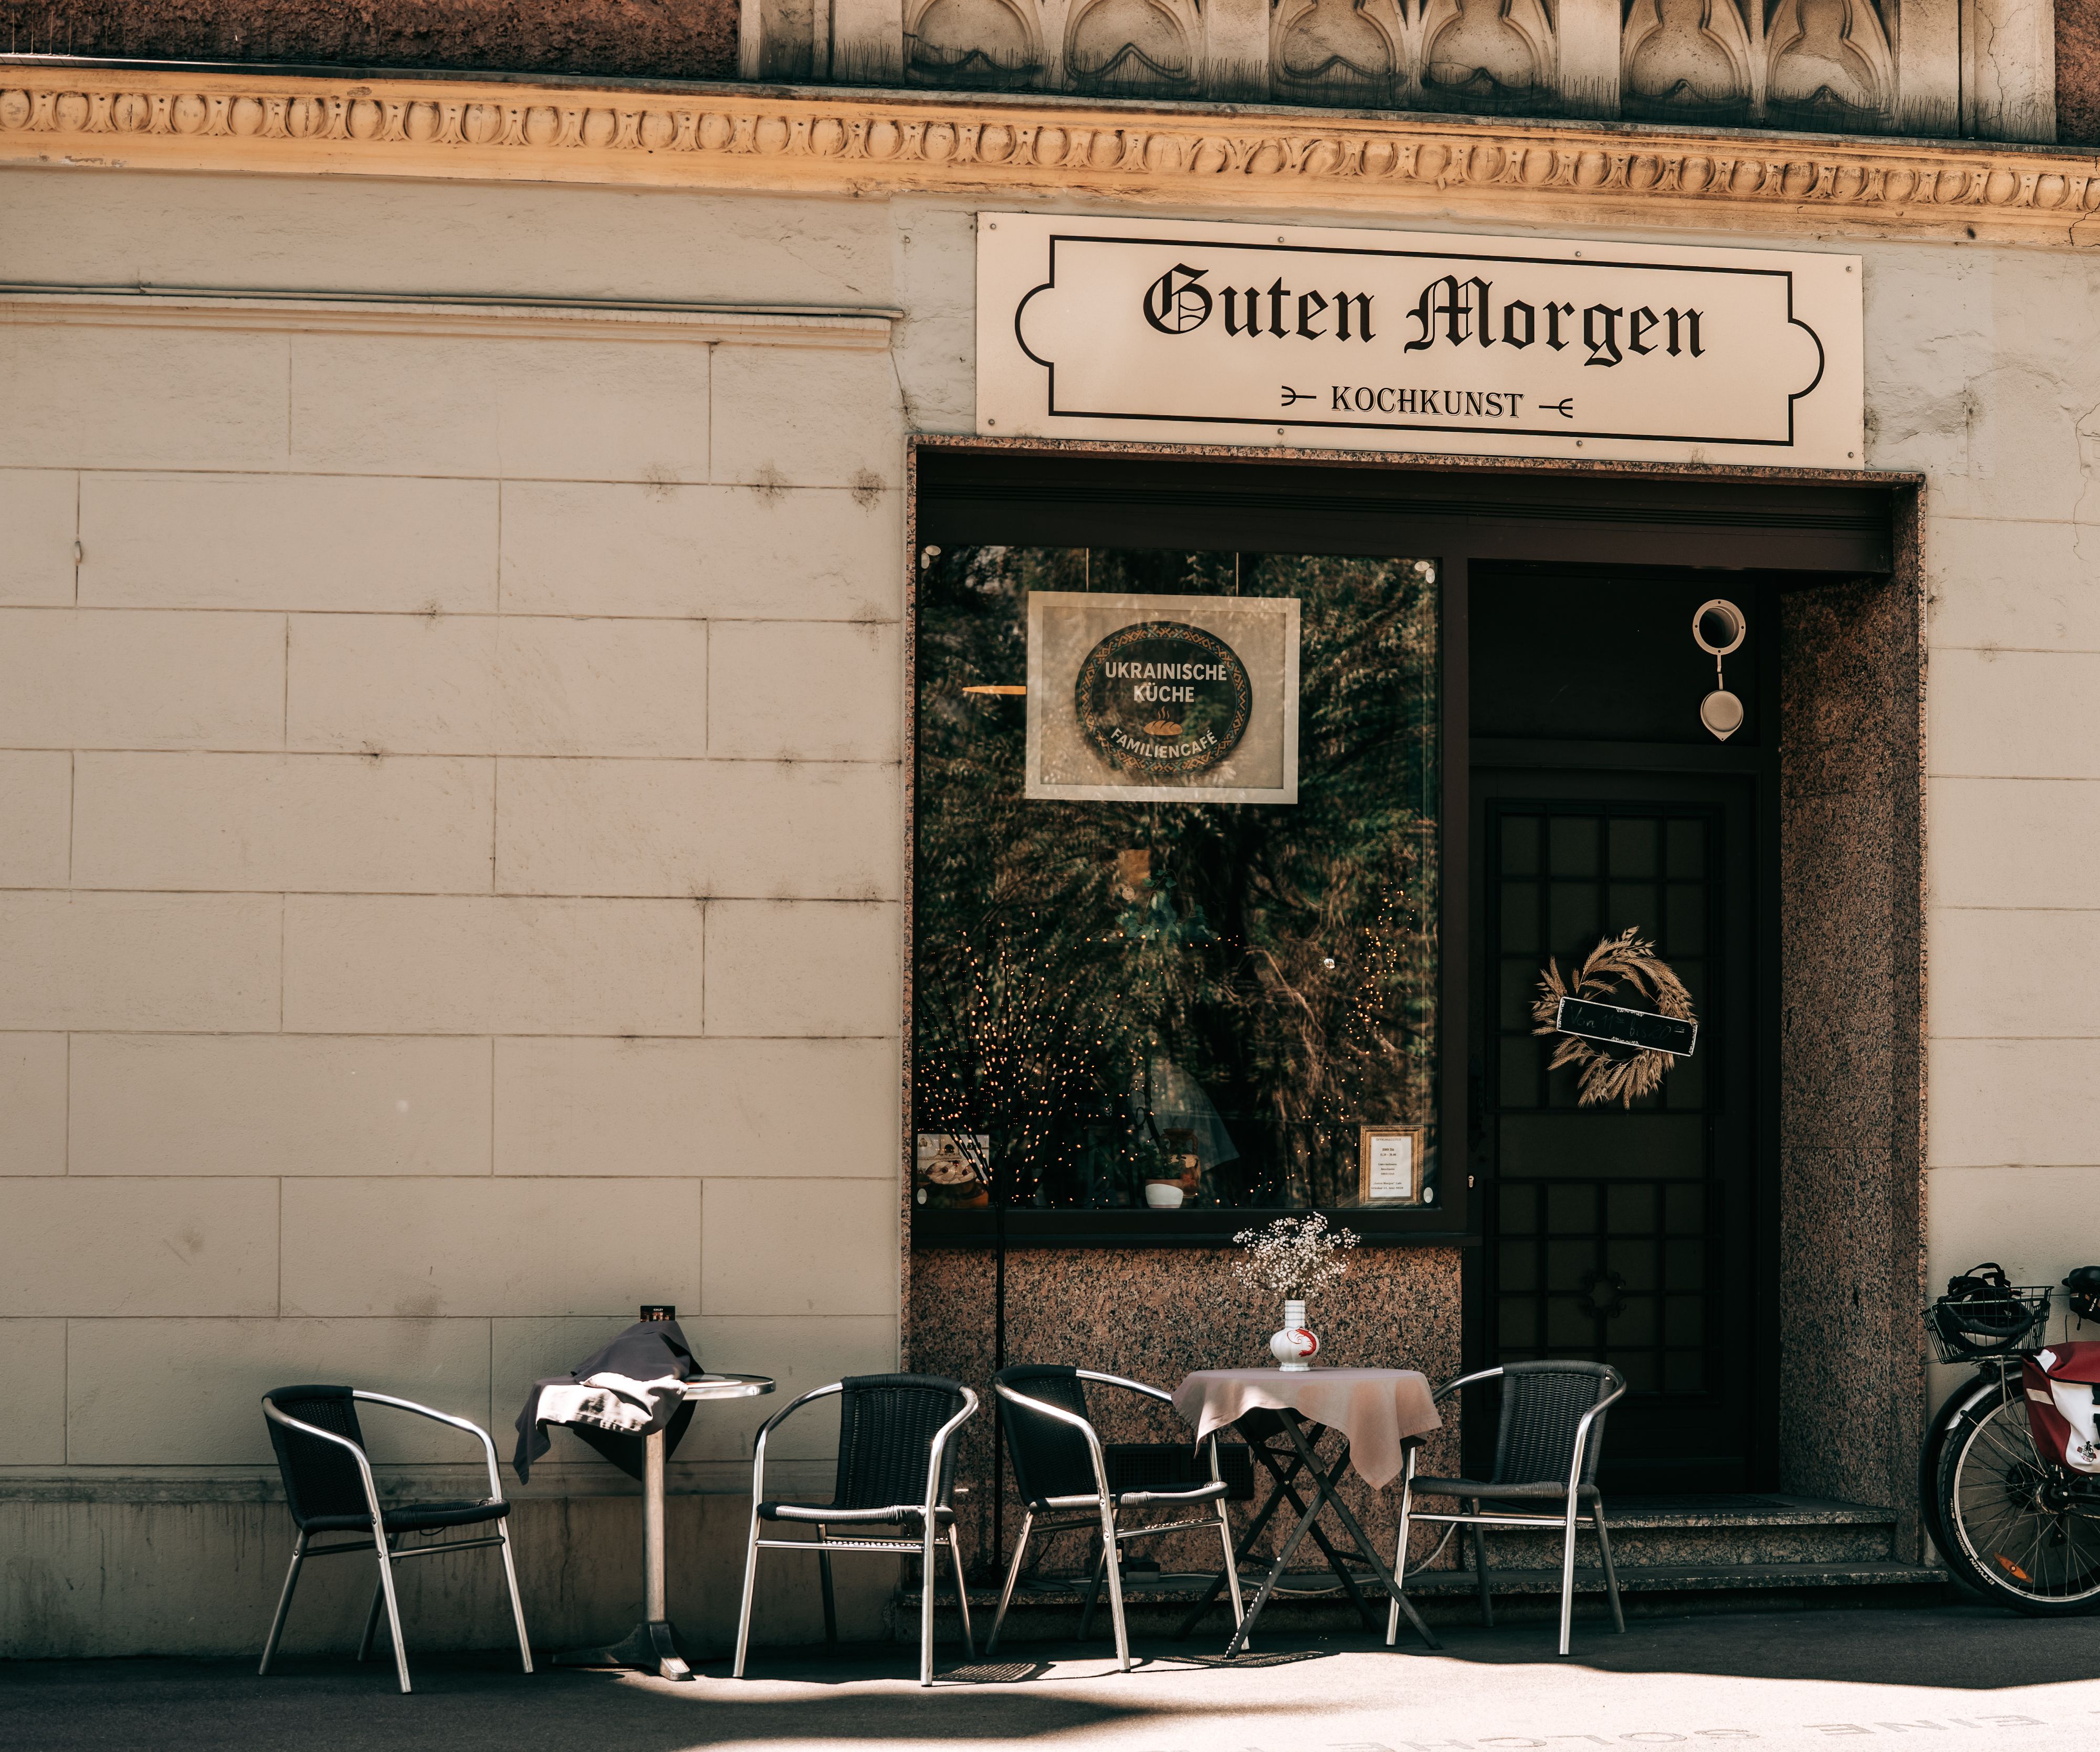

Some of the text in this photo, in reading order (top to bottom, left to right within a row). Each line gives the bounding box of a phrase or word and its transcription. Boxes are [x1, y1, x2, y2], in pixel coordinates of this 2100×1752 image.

[1143, 263, 1706, 368] Guten Morgen
[1331, 385, 1525, 419] KOCHKUNST
[1106, 662, 1227, 680] UKRAINISCHE
[1134, 683, 1194, 702] KÜCHE
[1110, 728, 1218, 758] FAMILIENCAFÉ
[1571, 1006, 1595, 1028] Von
[1802, 1714, 2049, 1735] EINE
